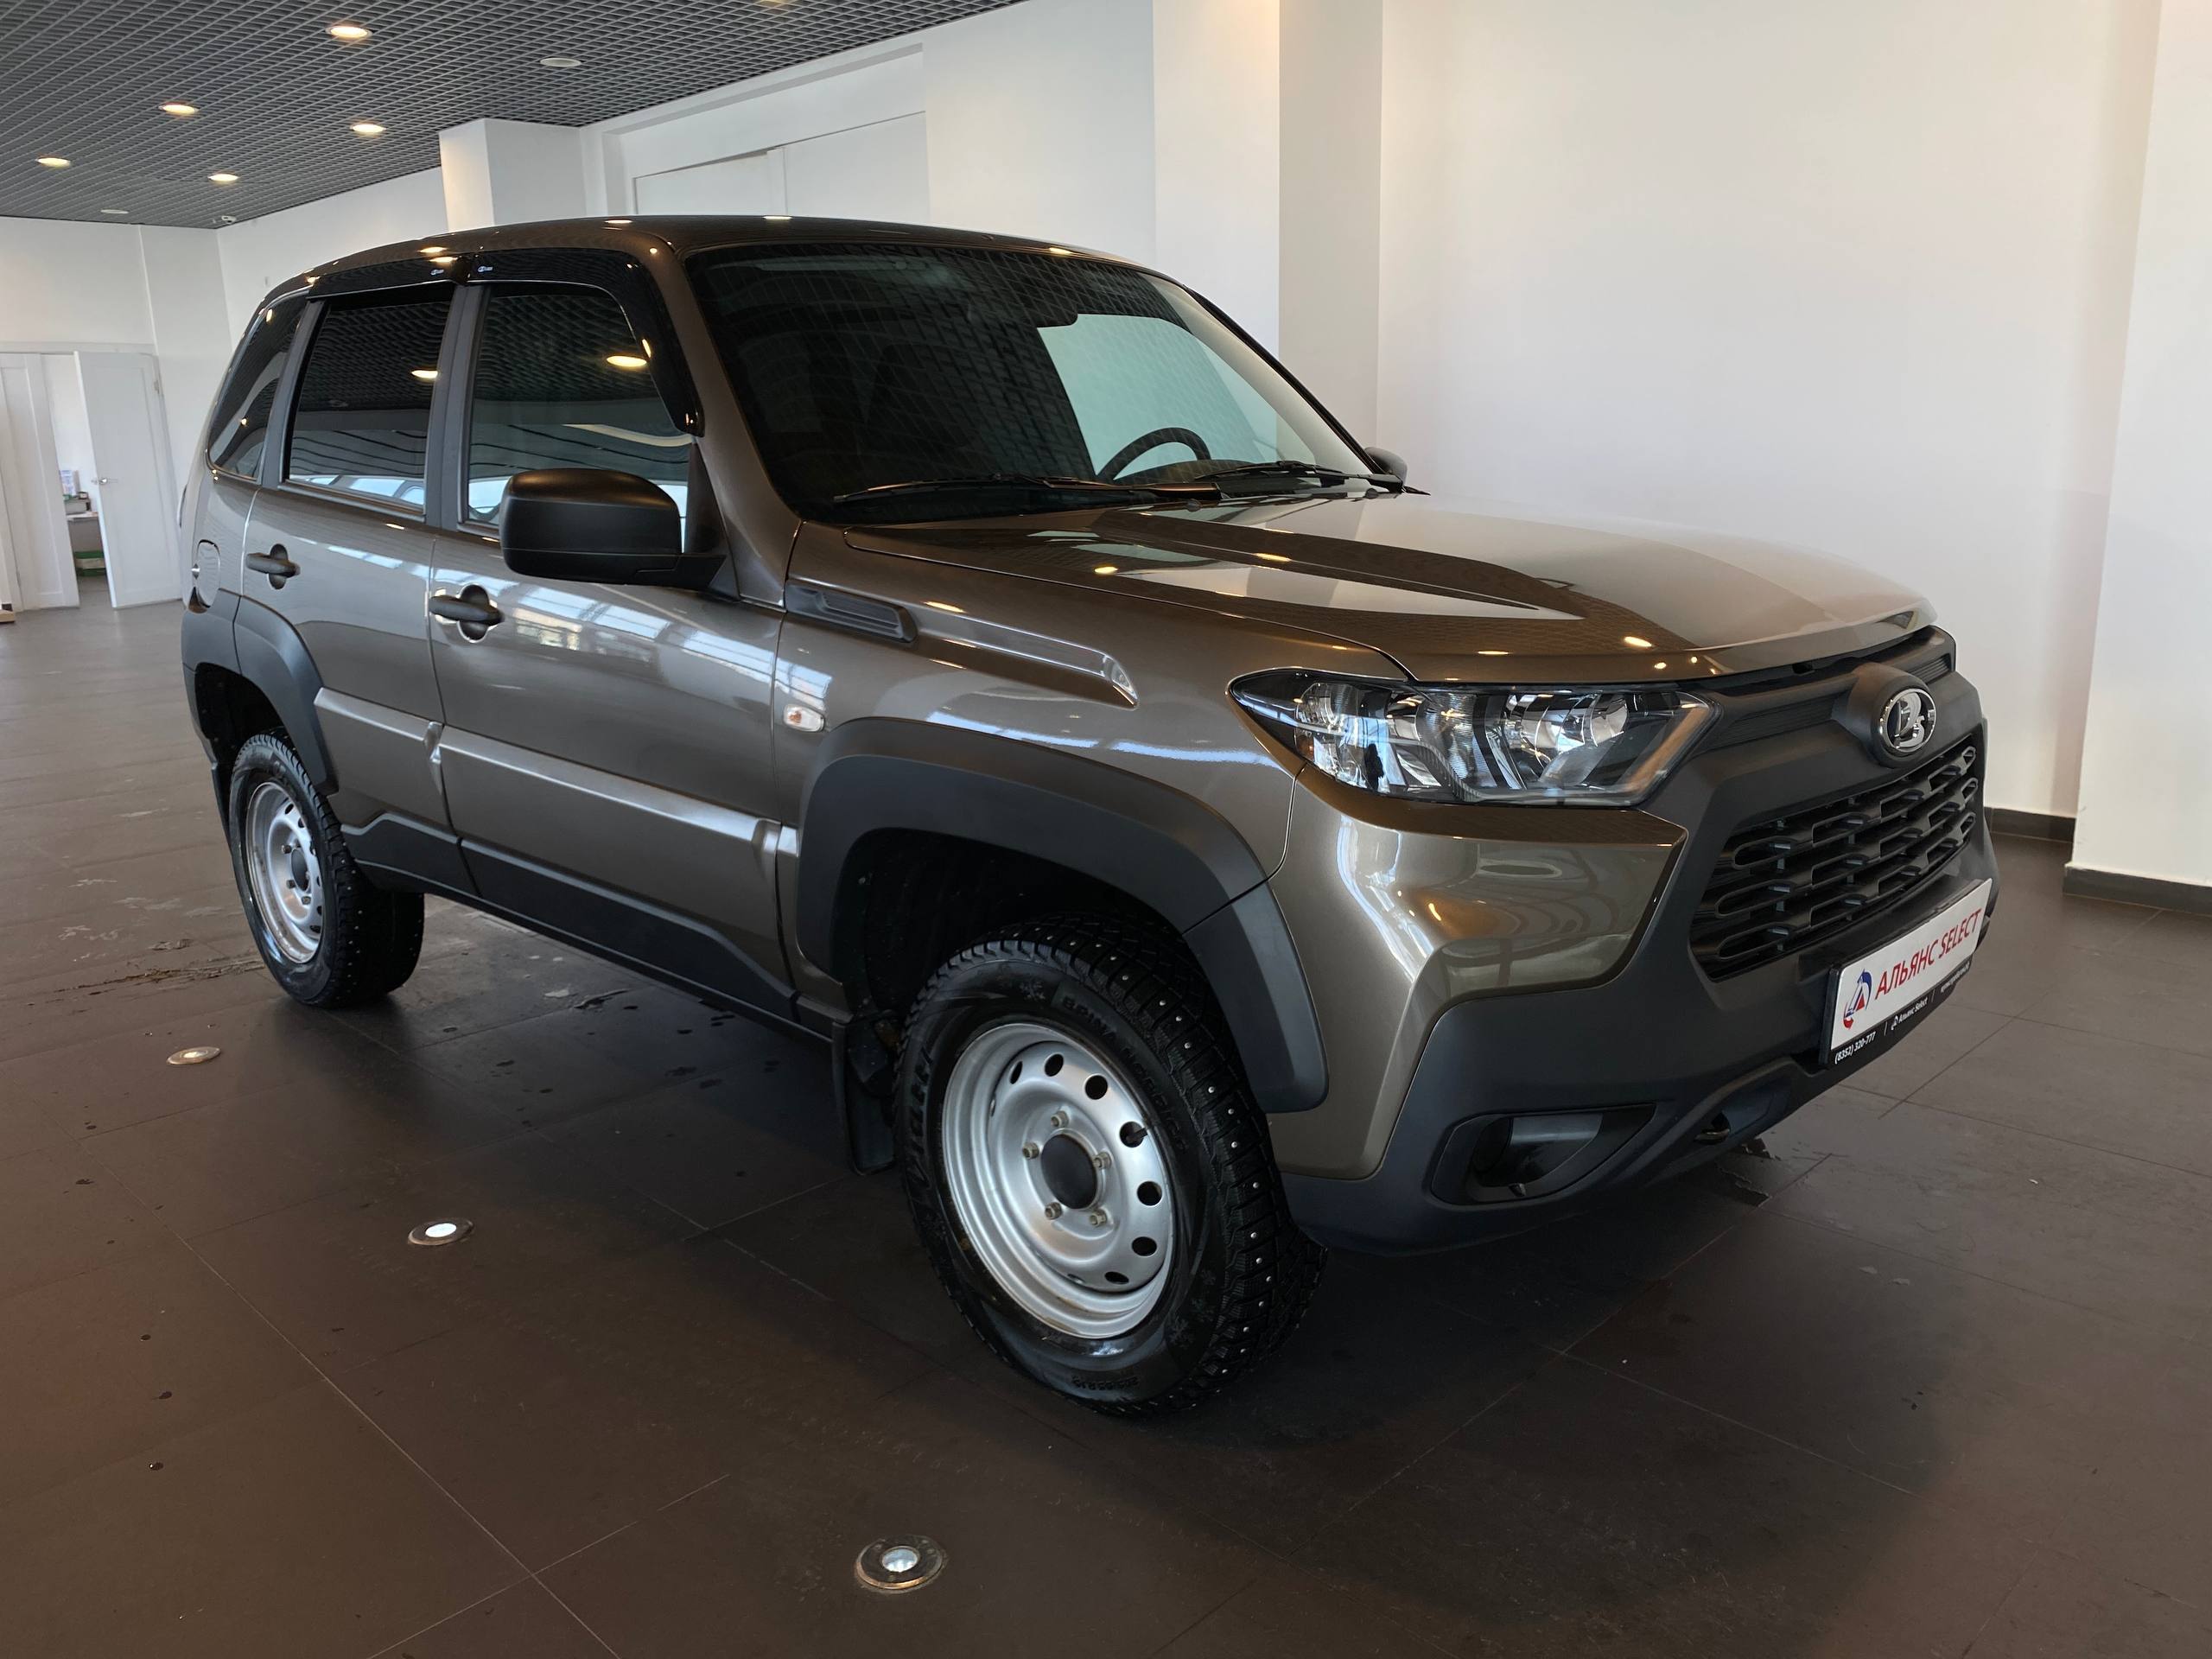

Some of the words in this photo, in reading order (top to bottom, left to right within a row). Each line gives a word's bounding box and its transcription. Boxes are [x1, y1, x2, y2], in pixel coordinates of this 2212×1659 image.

[1874, 941, 1939, 1001] АЛЬЯНС
[1938, 908, 1982, 958] SELECT
[1834, 1046, 1853, 1065] (8352)
[1853, 1031, 1877, 1052] 320-777
